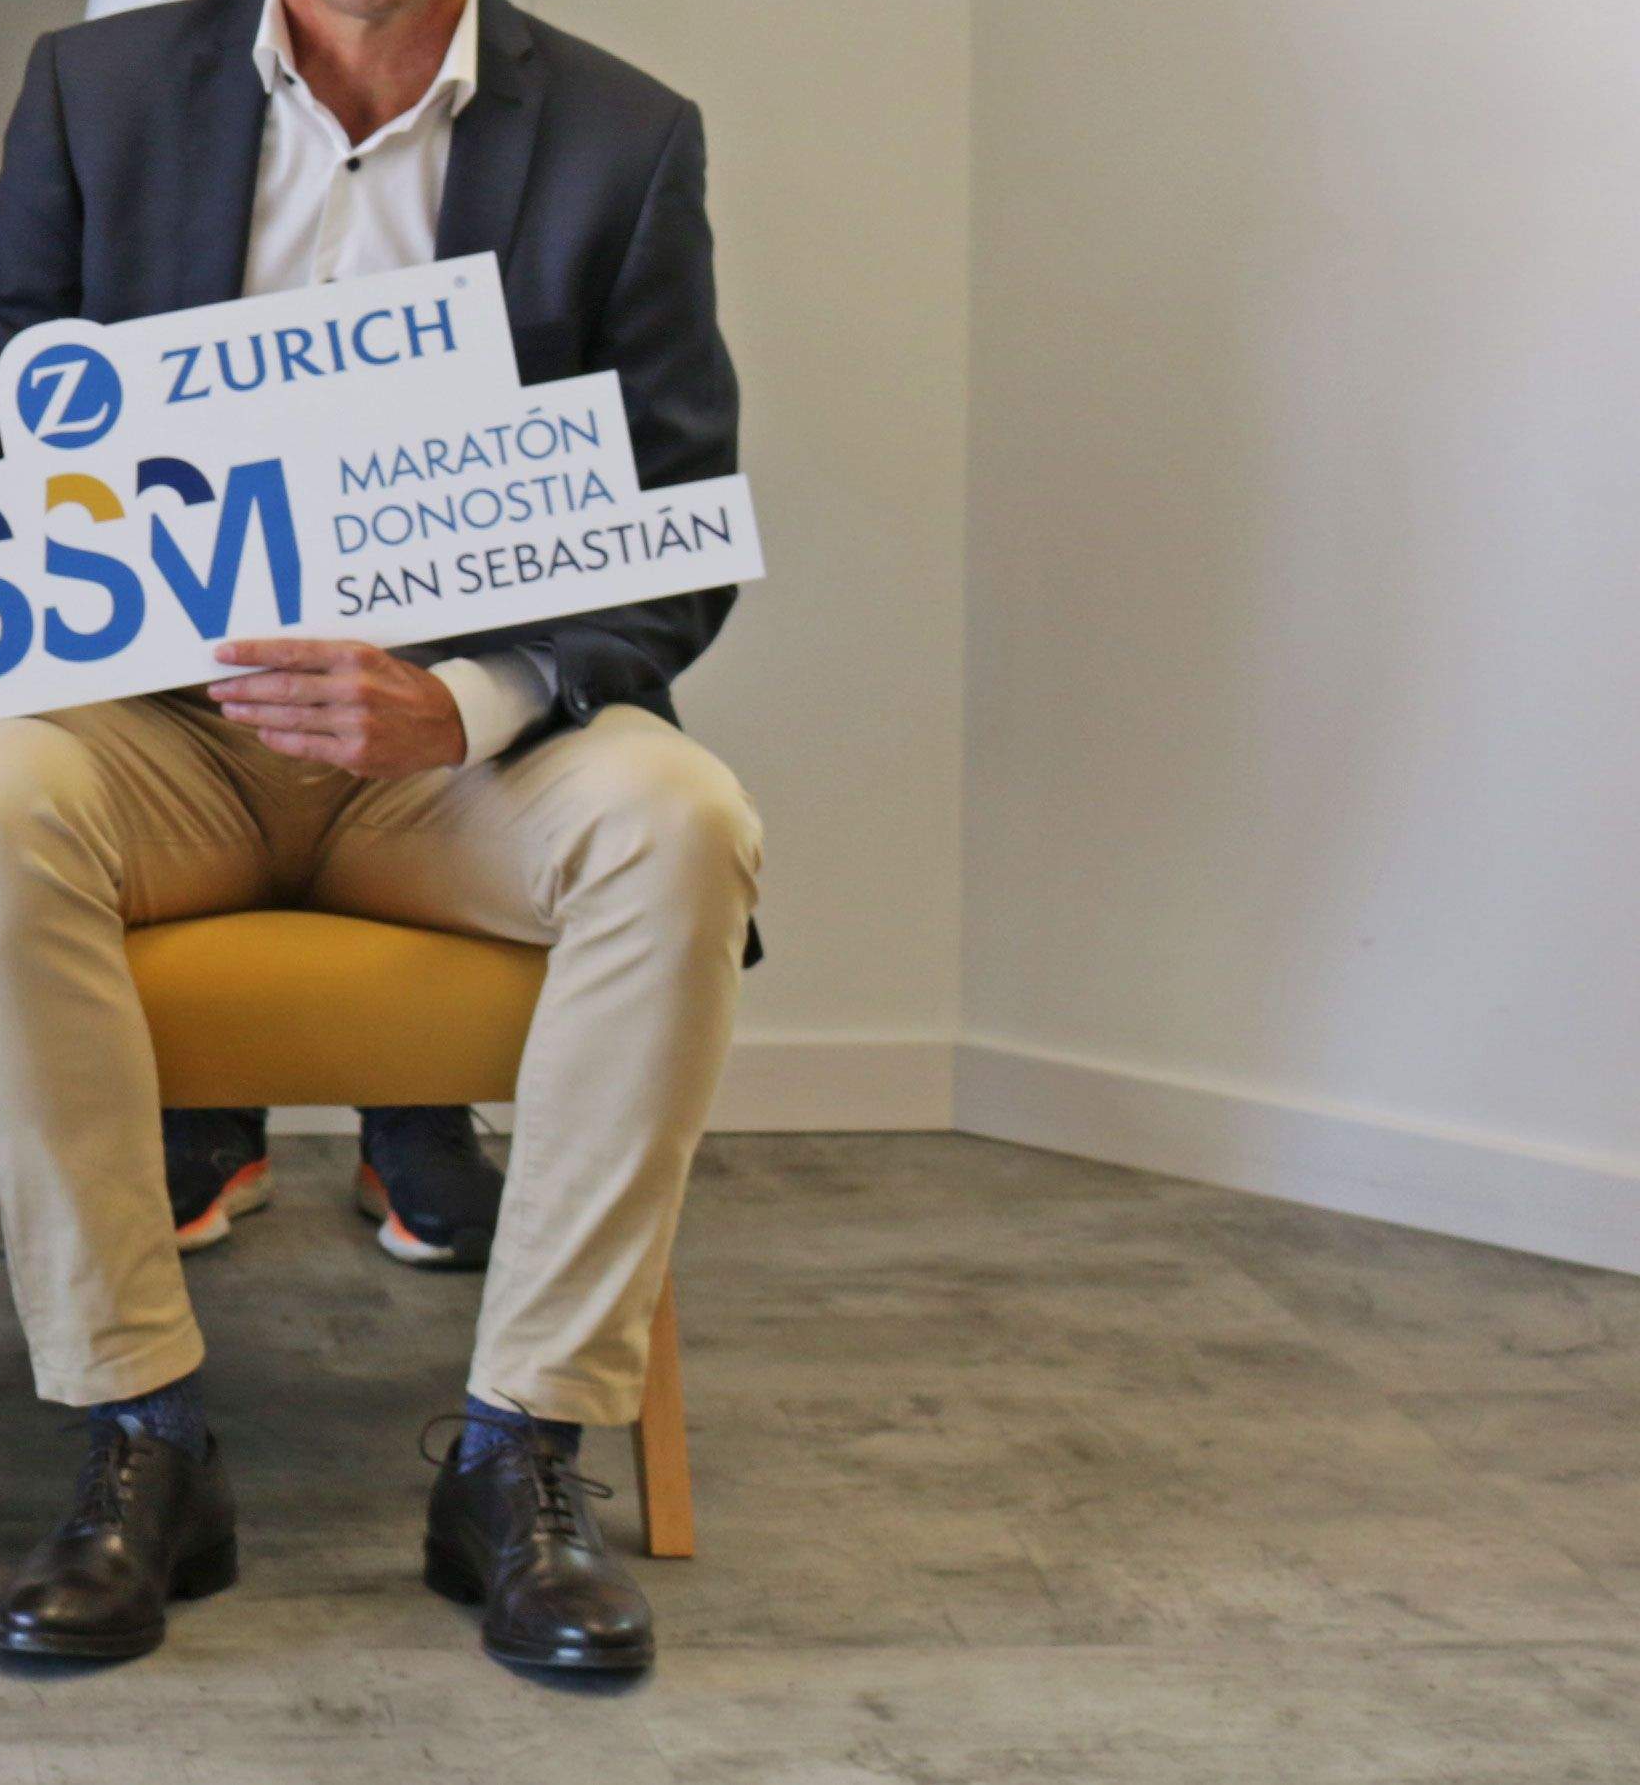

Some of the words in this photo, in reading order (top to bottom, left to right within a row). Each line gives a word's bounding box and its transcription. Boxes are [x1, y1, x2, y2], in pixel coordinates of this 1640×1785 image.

[161, 299, 458, 406] ZURICH
[339, 406, 603, 496] MARATÓN
[333, 470, 615, 556] DONOSTIA
[336, 560, 442, 616] SAN
[456, 504, 733, 593] SEBASTIÁN
